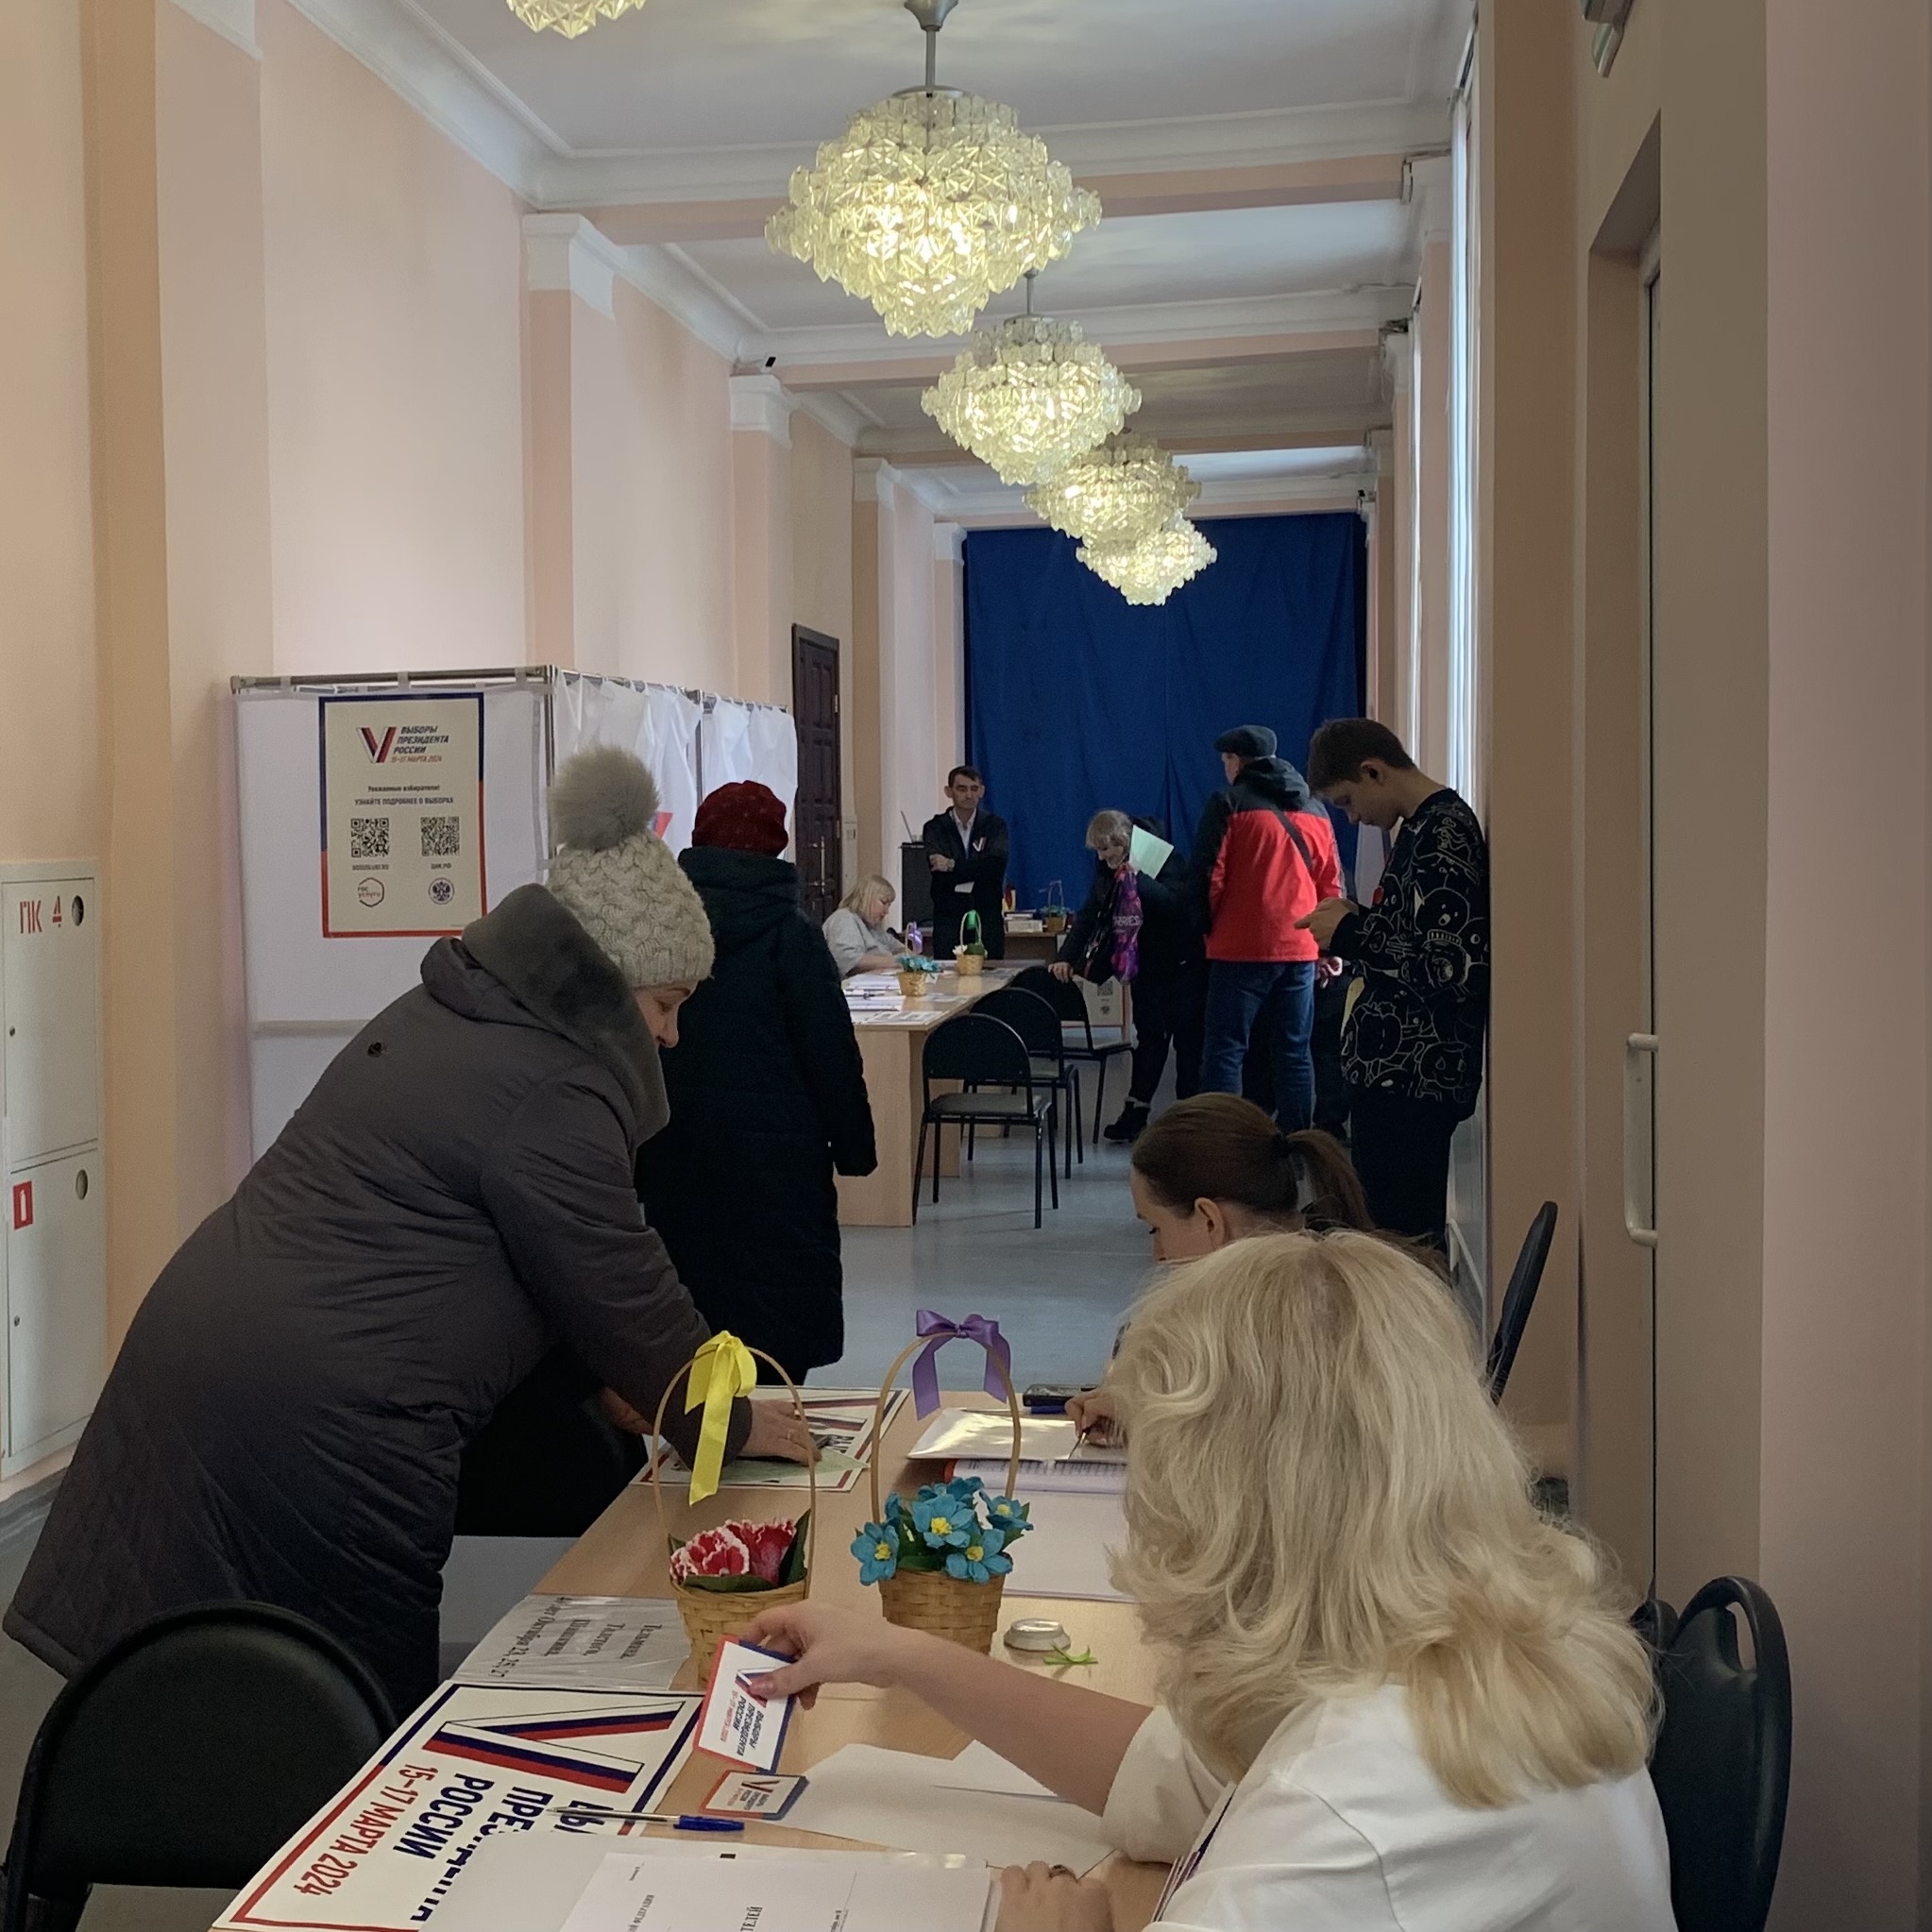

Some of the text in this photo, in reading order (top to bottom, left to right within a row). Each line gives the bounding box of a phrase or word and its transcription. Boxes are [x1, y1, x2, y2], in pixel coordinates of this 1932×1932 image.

[393, 746, 427, 754] РОССИИ
[397, 736, 449, 744] ПРЕЗИДЕНТА
[382, 797, 418, 805] ПОДРОБНЕЕ
[20, 895, 62, 934] ПК 4
[732, 1695, 747, 1732] РОССИИ
[737, 1703, 756, 1756] ПРЕЗИДЕНТА
[749, 1710, 765, 1750] ВЫБОРЫ
[329, 1802, 406, 1856] МАРТА
[393, 1773, 495, 1859] РОССИИ
[293, 1853, 358, 1896] 2024
